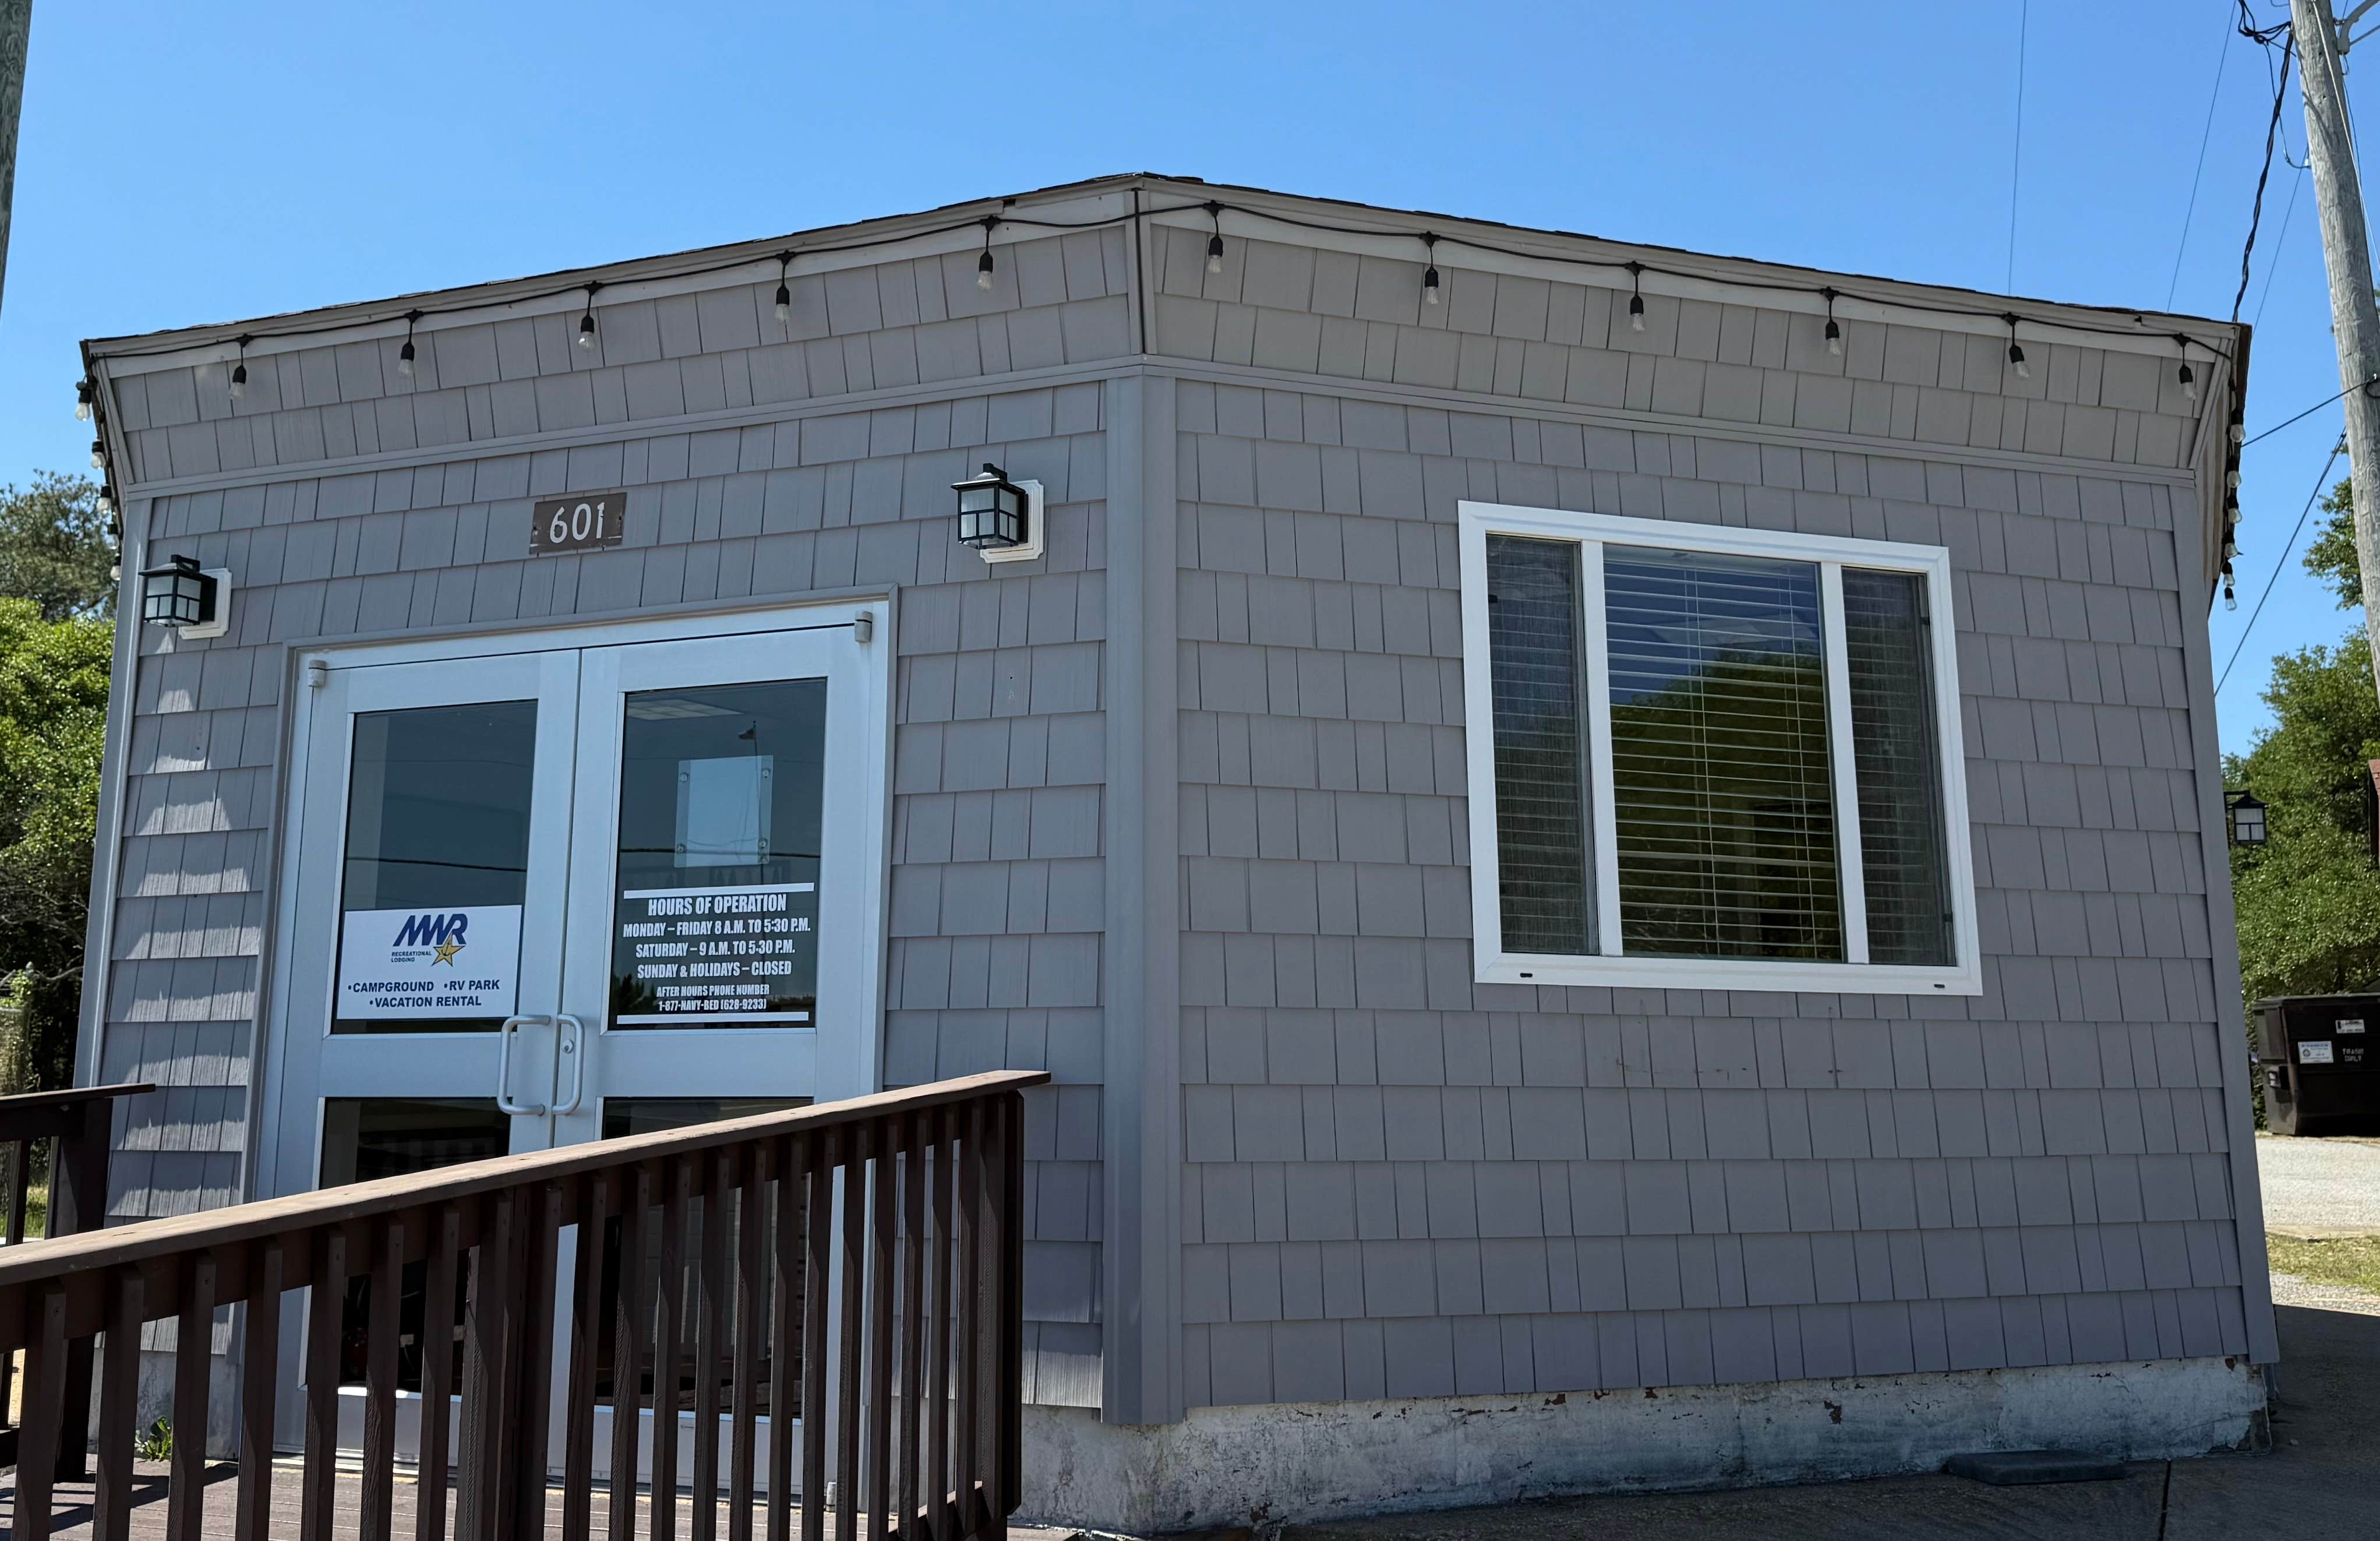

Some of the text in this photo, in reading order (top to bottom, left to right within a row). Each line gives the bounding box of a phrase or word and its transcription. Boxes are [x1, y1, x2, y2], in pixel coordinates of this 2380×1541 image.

[550, 502, 605, 544] 601
[648, 894, 786, 916] HOURS OF OPERATION
[393, 914, 468, 946] MWR
[623, 923, 666, 937] MONDAY
[676, 921, 712, 936] FRIDAY
[714, 921, 722, 934] 8
[723, 919, 746, 934] A.M.
[748, 919, 762, 932] TO
[764, 918, 789, 932] 5:30
[790, 918, 811, 932] P.M.
[635, 943, 688, 958] SATURDAY
[699, 942, 707, 955] 9
[708, 941, 730, 955] A.M.
[733, 941, 746, 954] TO
[775, 939, 796, 953] P.M.
[637, 964, 678, 979] SUNDAY
[680, 965, 687, 977] &
[690, 962, 740, 977] HOLIDAYS
[751, 961, 792, 976] CLOSED
[468, 979, 500, 990] PARK
[656, 984, 769, 997] AFTER HOURS PHONE NUMBER
[436, 996, 482, 1006] RENTAL
[658, 999, 719, 1011] 1-877-NAVY-BED
